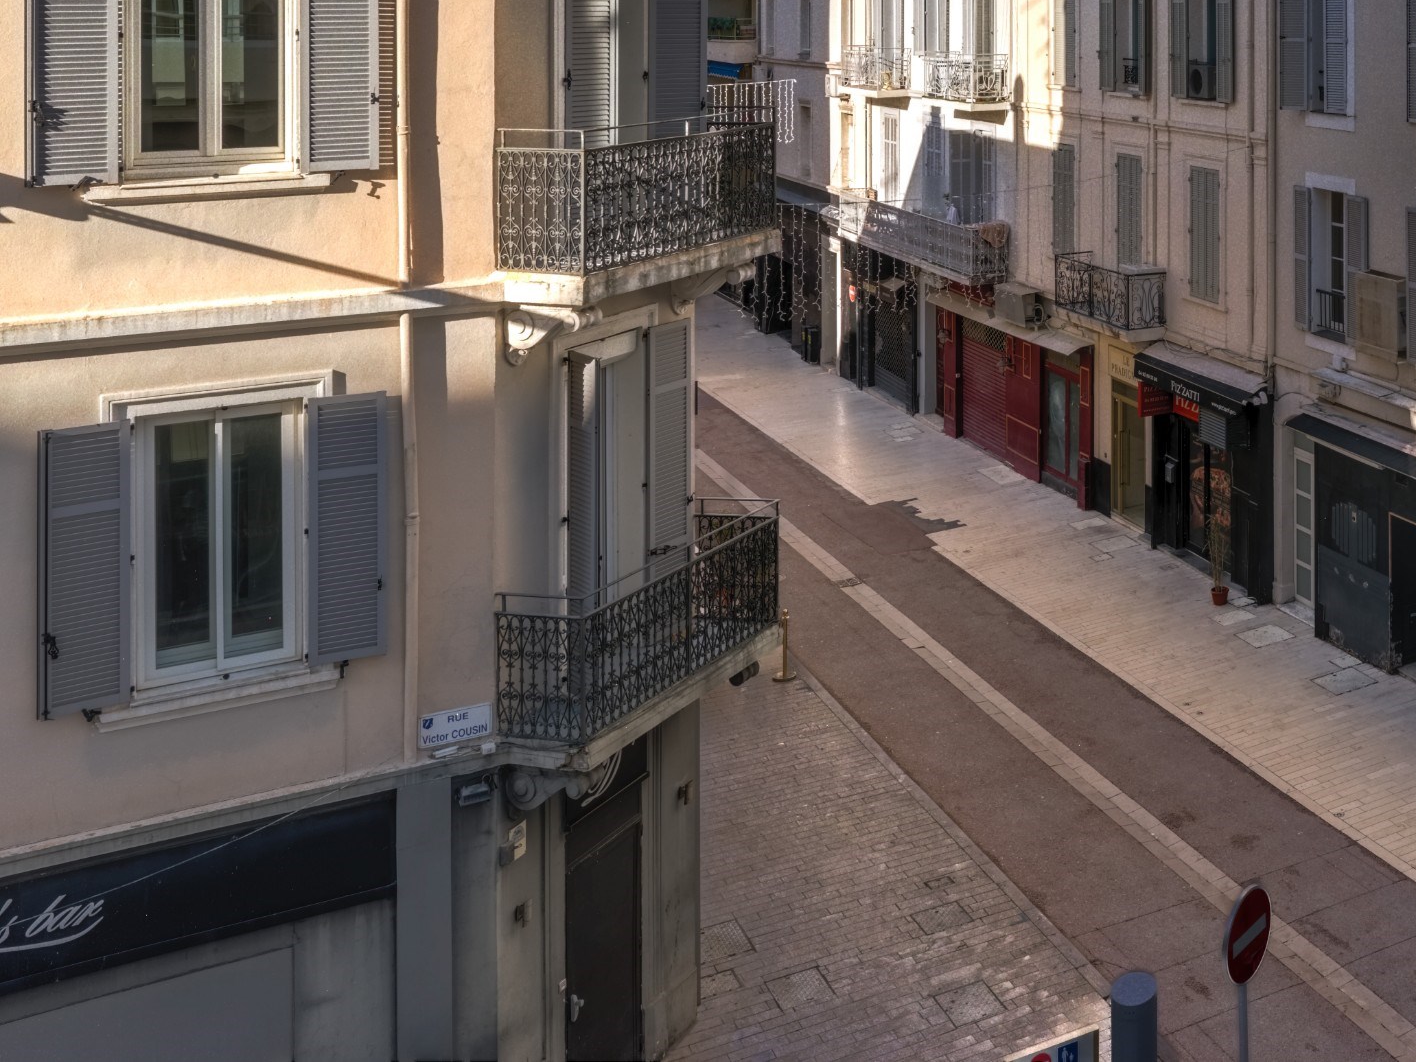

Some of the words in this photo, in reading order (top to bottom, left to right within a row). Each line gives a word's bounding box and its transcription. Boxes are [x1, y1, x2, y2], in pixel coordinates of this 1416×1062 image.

[447, 712, 469, 723] RUE
[422, 733, 449, 745] Victor
[451, 723, 488, 739] COUSIN
[24, 894, 105, 938] bar
